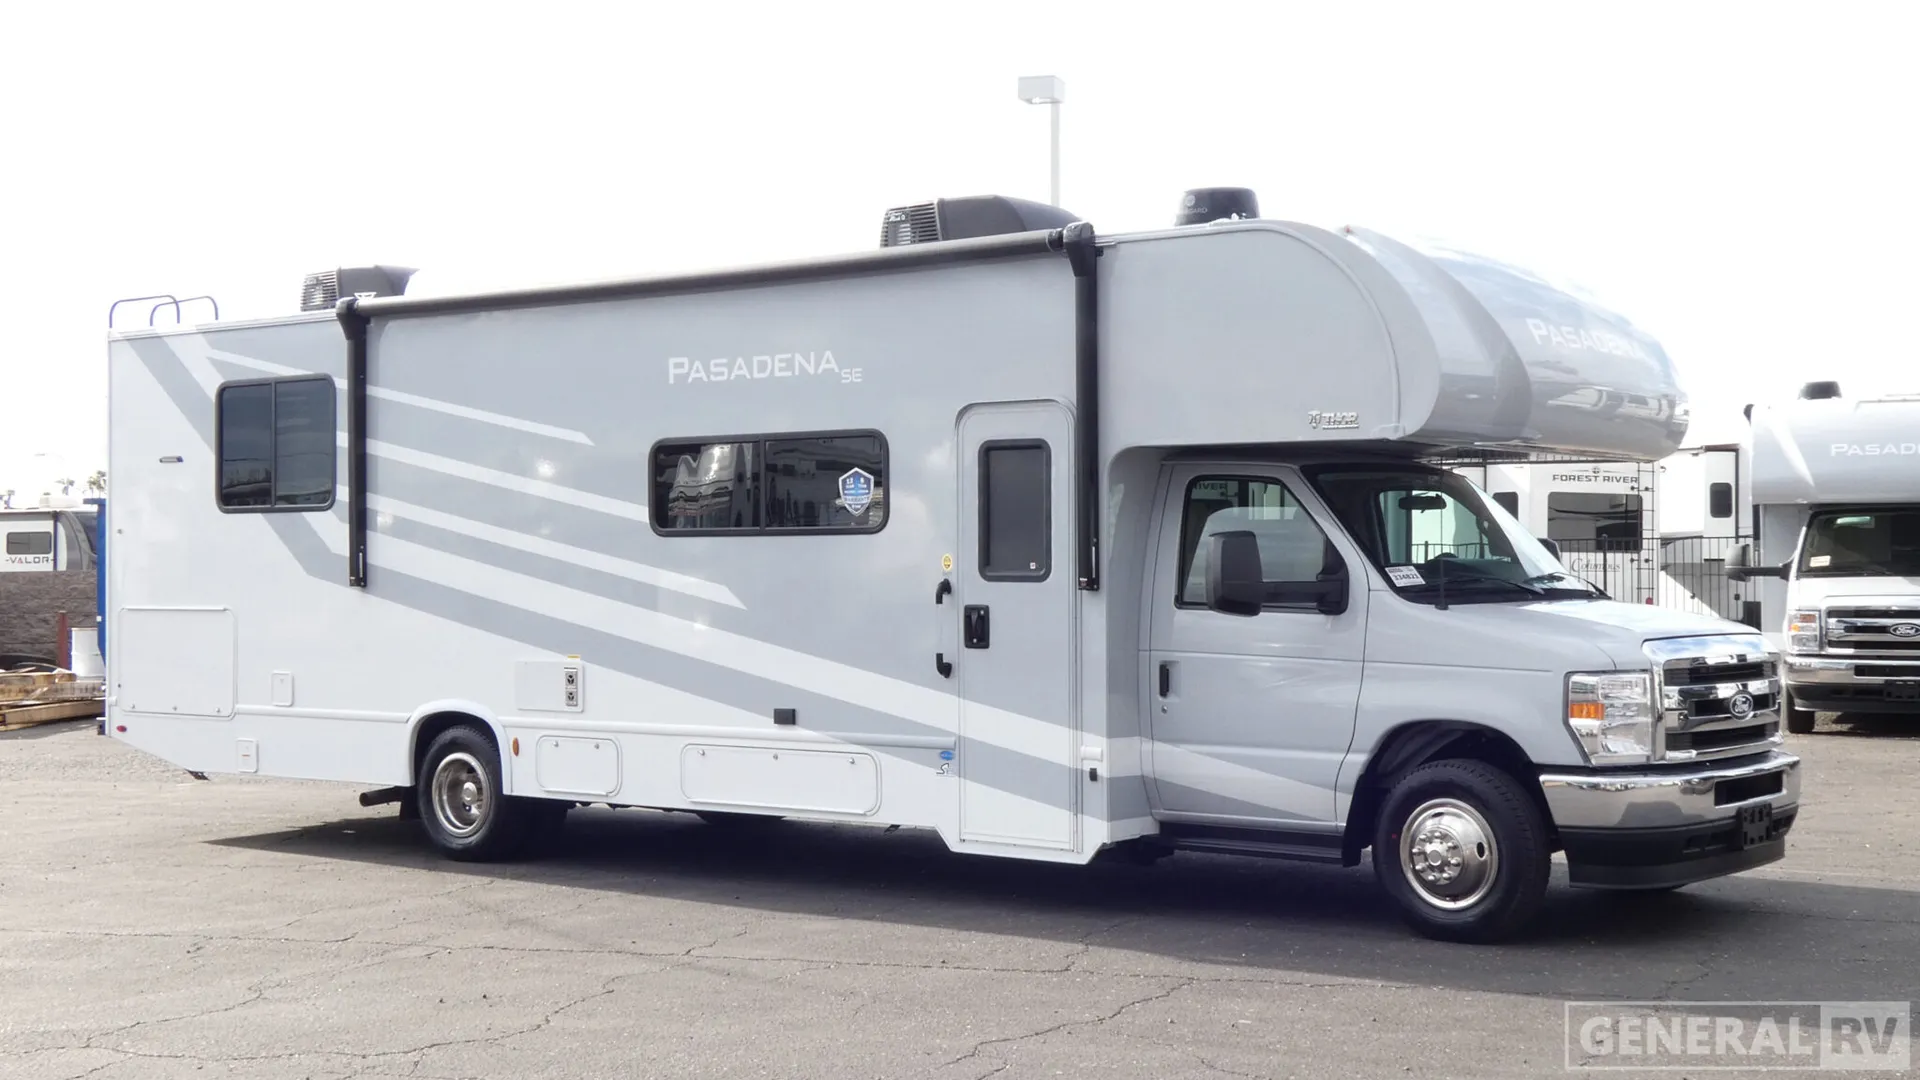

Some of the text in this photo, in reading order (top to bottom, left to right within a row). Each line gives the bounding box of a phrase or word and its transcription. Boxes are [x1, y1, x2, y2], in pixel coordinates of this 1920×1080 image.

[668, 350, 863, 385] PASADENA SE
[1552, 474, 1639, 484] FOREST RIVER
